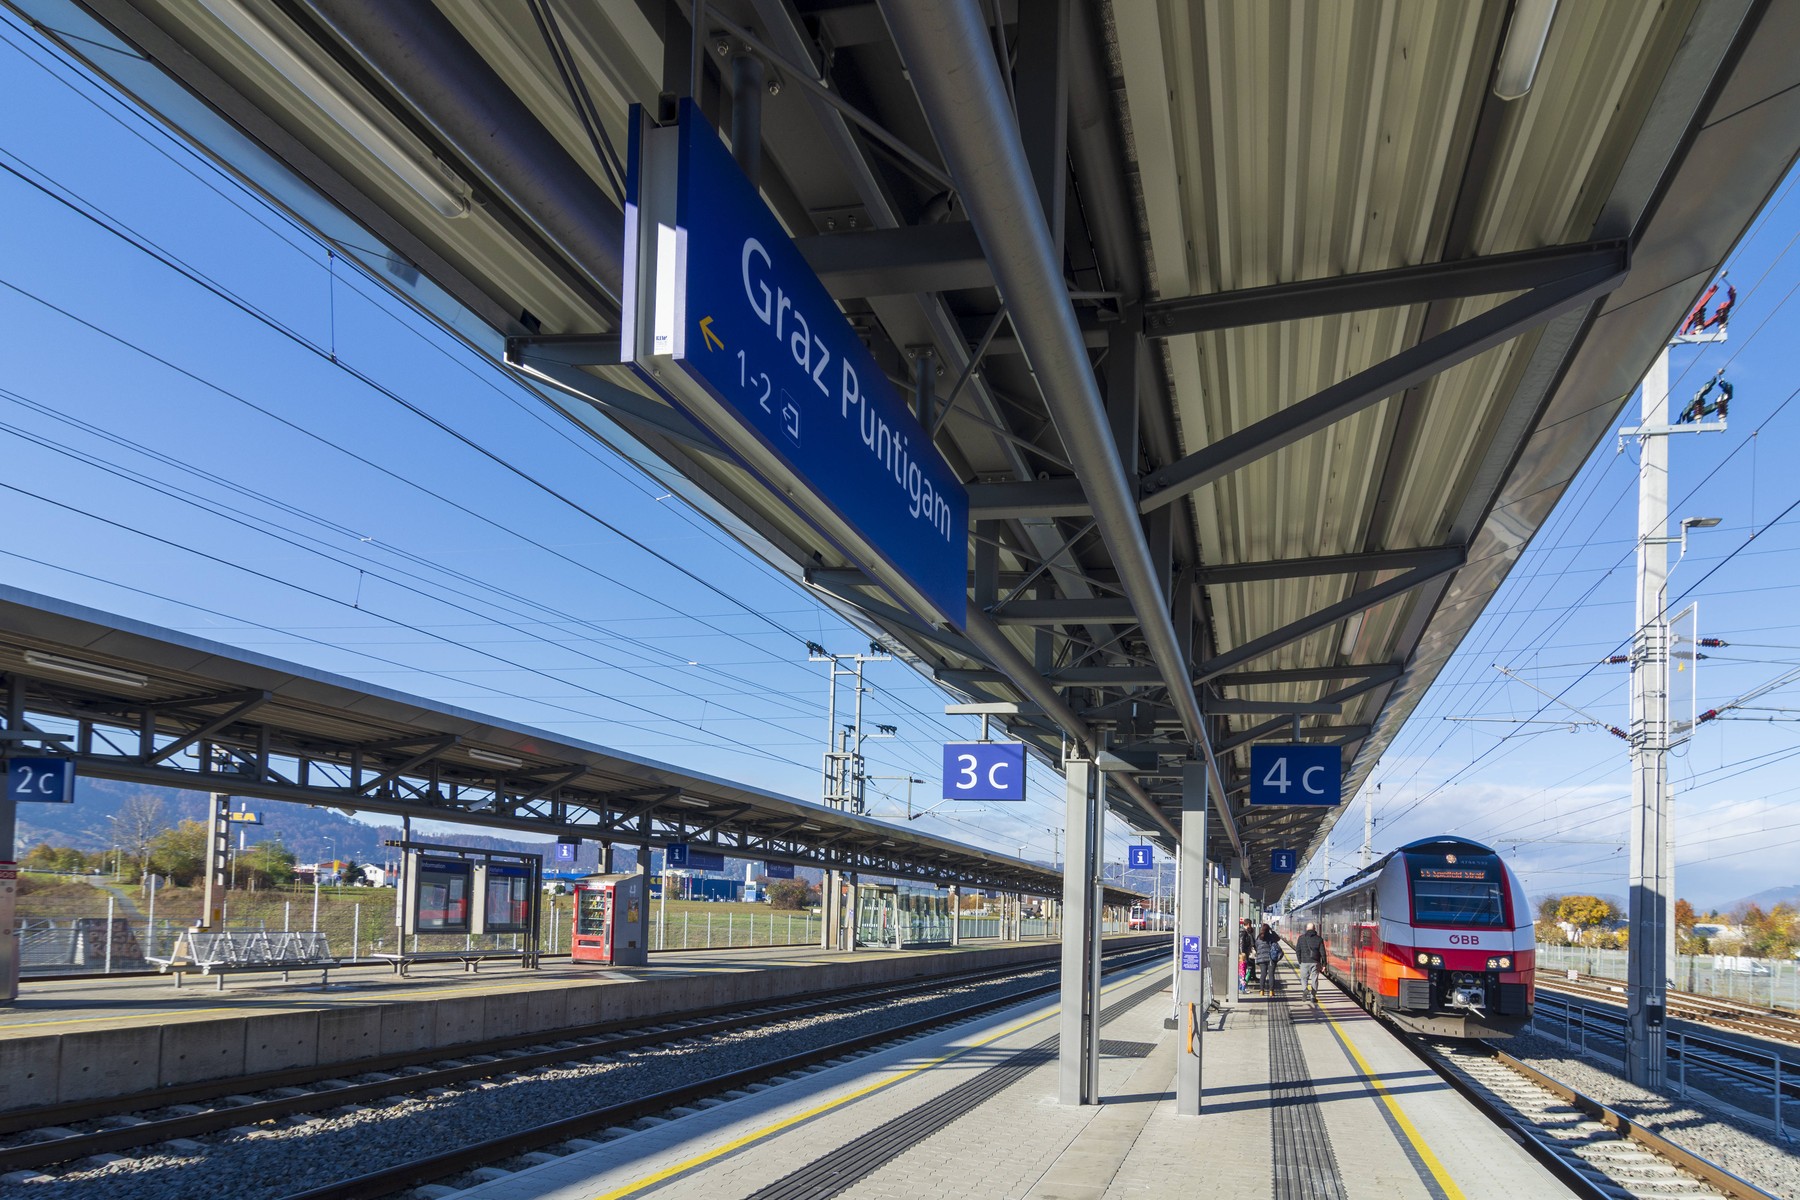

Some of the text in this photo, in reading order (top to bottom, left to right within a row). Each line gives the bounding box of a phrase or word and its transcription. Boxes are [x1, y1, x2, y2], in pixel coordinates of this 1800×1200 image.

[737, 349, 771, 415] 1-2
[741, 237, 951, 542] Graz Puntigam
[16, 765, 55, 794] 2 c
[956, 754, 1009, 790] 3 c
[1262, 757, 1325, 795] 4 c
[1449, 934, 1480, 945] ÖBB
